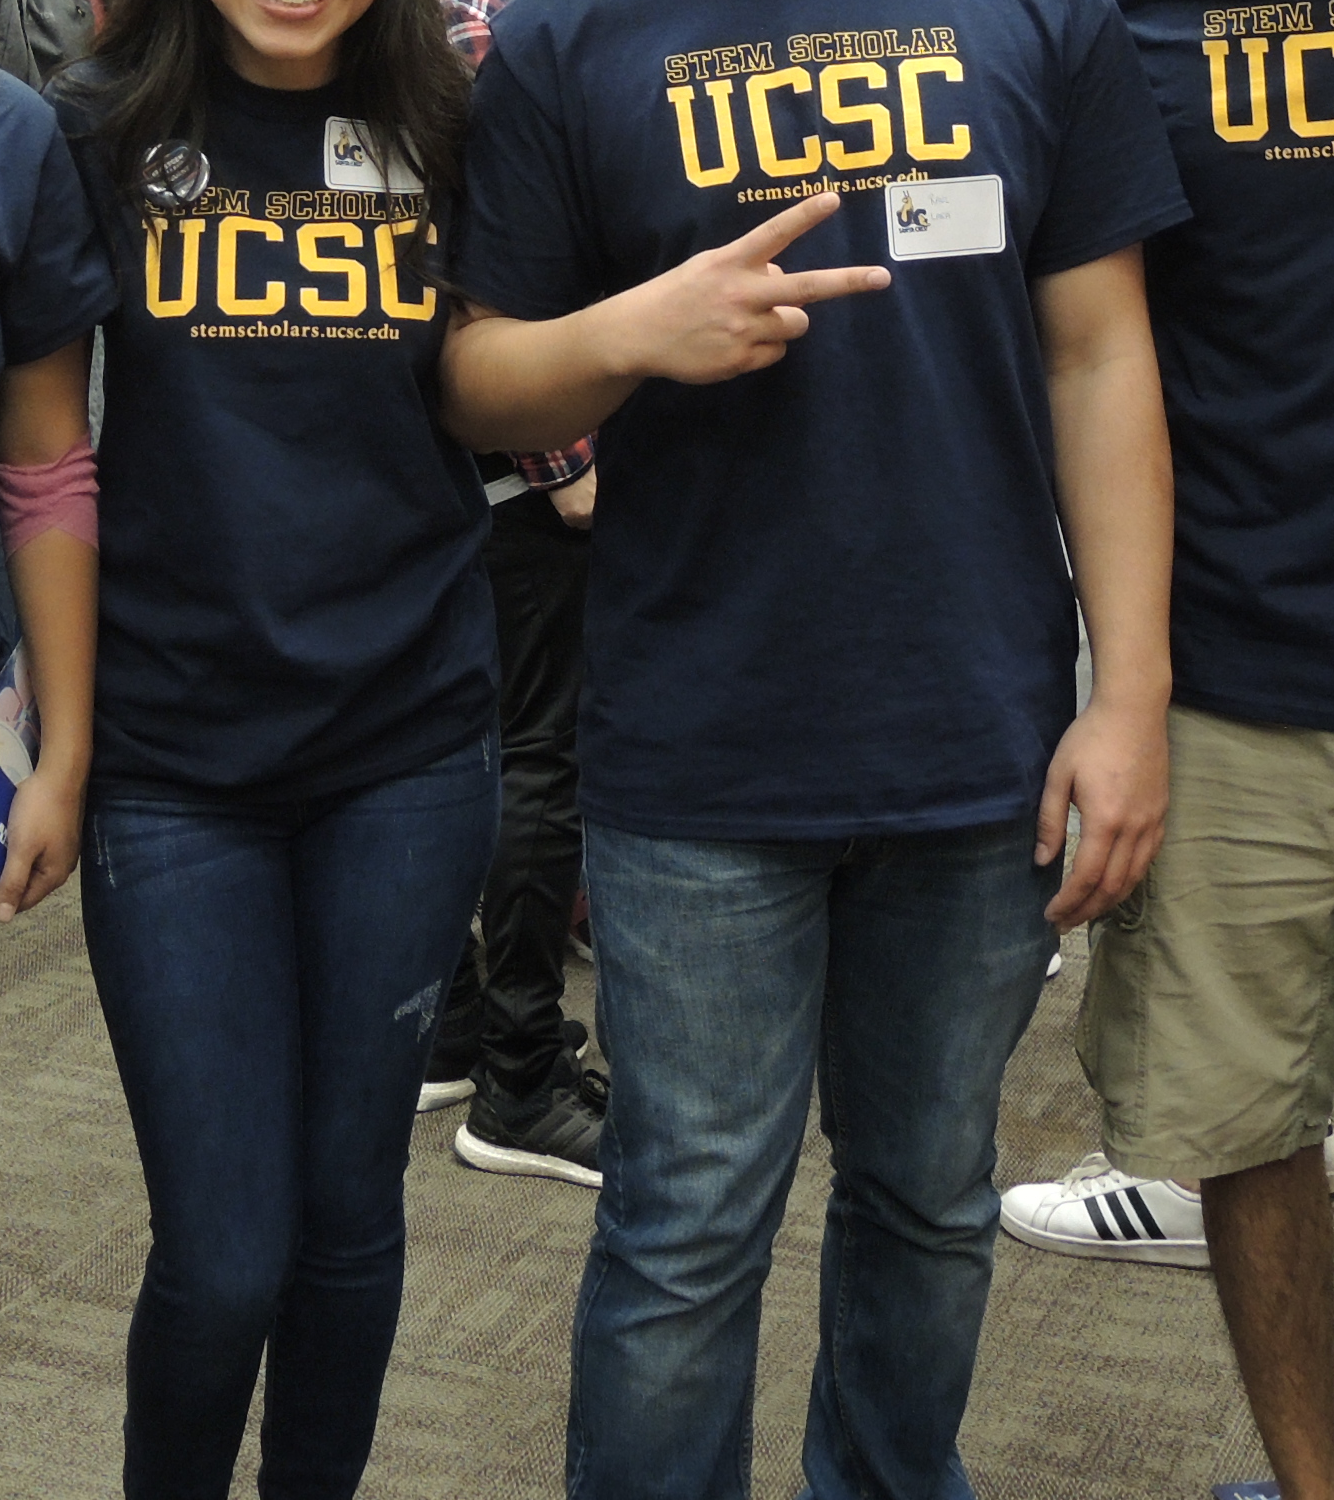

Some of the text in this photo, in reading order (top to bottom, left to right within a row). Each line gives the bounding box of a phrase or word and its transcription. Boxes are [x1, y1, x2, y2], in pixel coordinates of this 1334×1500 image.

[1203, 2, 1313, 37] STEM
[665, 27, 957, 83] STEM SCHOLAR
[667, 56, 971, 188] UCSC
[145, 187, 249, 215] EM
[142, 215, 438, 322] UCSC
[190, 320, 400, 340] stemscholars.ucsc.edu
